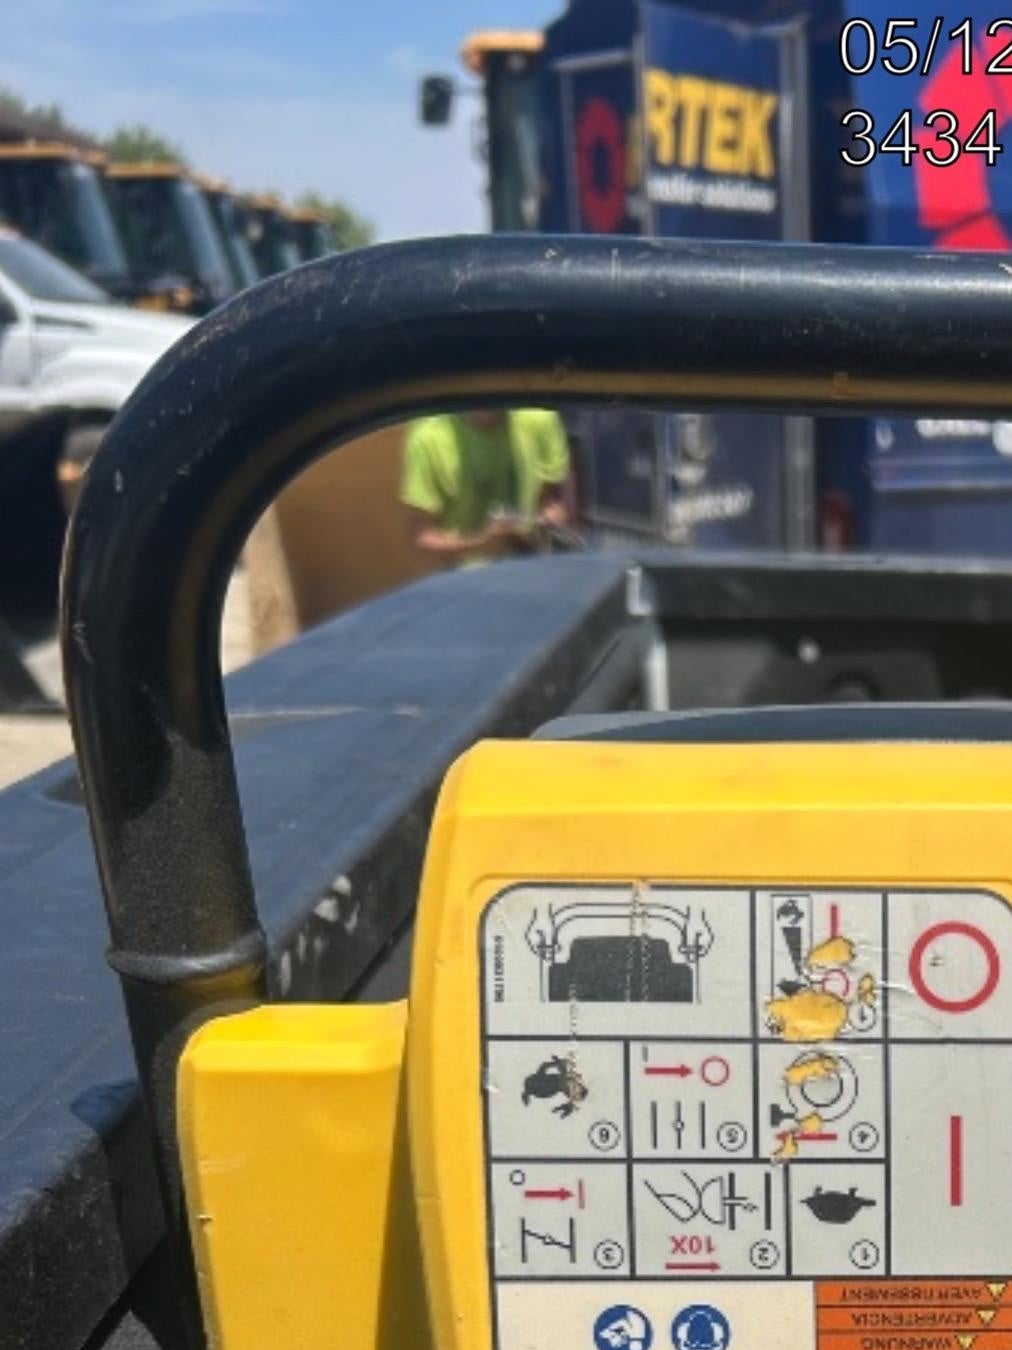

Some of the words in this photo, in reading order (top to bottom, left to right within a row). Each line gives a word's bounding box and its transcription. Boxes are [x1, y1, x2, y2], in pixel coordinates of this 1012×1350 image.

[726, 1130, 737, 1145] 5
[858, 1130, 870, 1145] 4
[669, 1234, 716, 1254] 10X
[604, 1247, 615, 1262] 3
[758, 1247, 769, 1262] 2
[840, 1286, 982, 1303] AVERTISSEMENT
[851, 1312, 973, 1327] ADVERTENCIA
